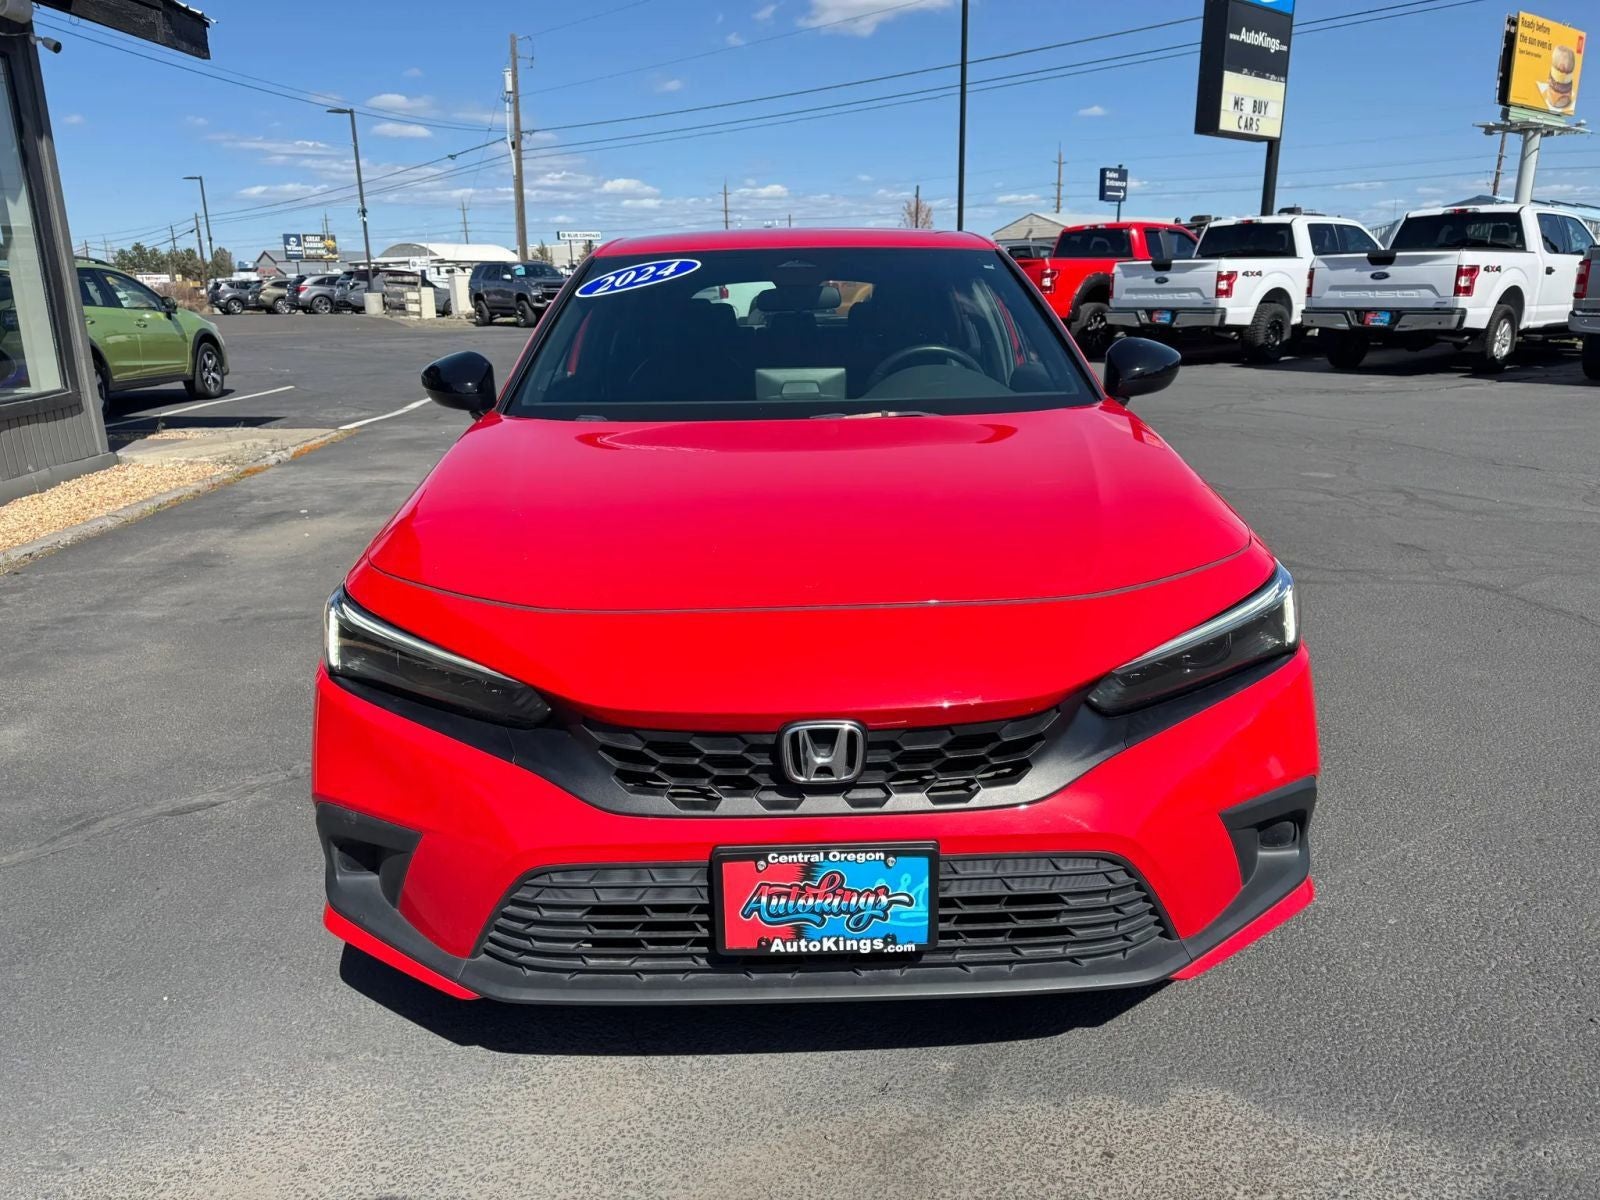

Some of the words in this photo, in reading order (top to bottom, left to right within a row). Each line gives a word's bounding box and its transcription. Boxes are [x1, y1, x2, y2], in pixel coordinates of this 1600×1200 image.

[1521, 17, 1535, 32] Ready
[1536, 21, 1551, 35] before
[1520, 33, 1528, 43] the
[1528, 37, 1537, 46] sun
[1233, 96, 1244, 112] WE
[1252, 99, 1269, 115] BUY
[1237, 115, 1260, 132] CARS
[1106, 179, 1126, 187] Entrance
[593, 261, 681, 295] 2024
[767, 852, 824, 864] Central
[828, 851, 885, 863] Oregon
[769, 936, 916, 954] AutoKings.com
